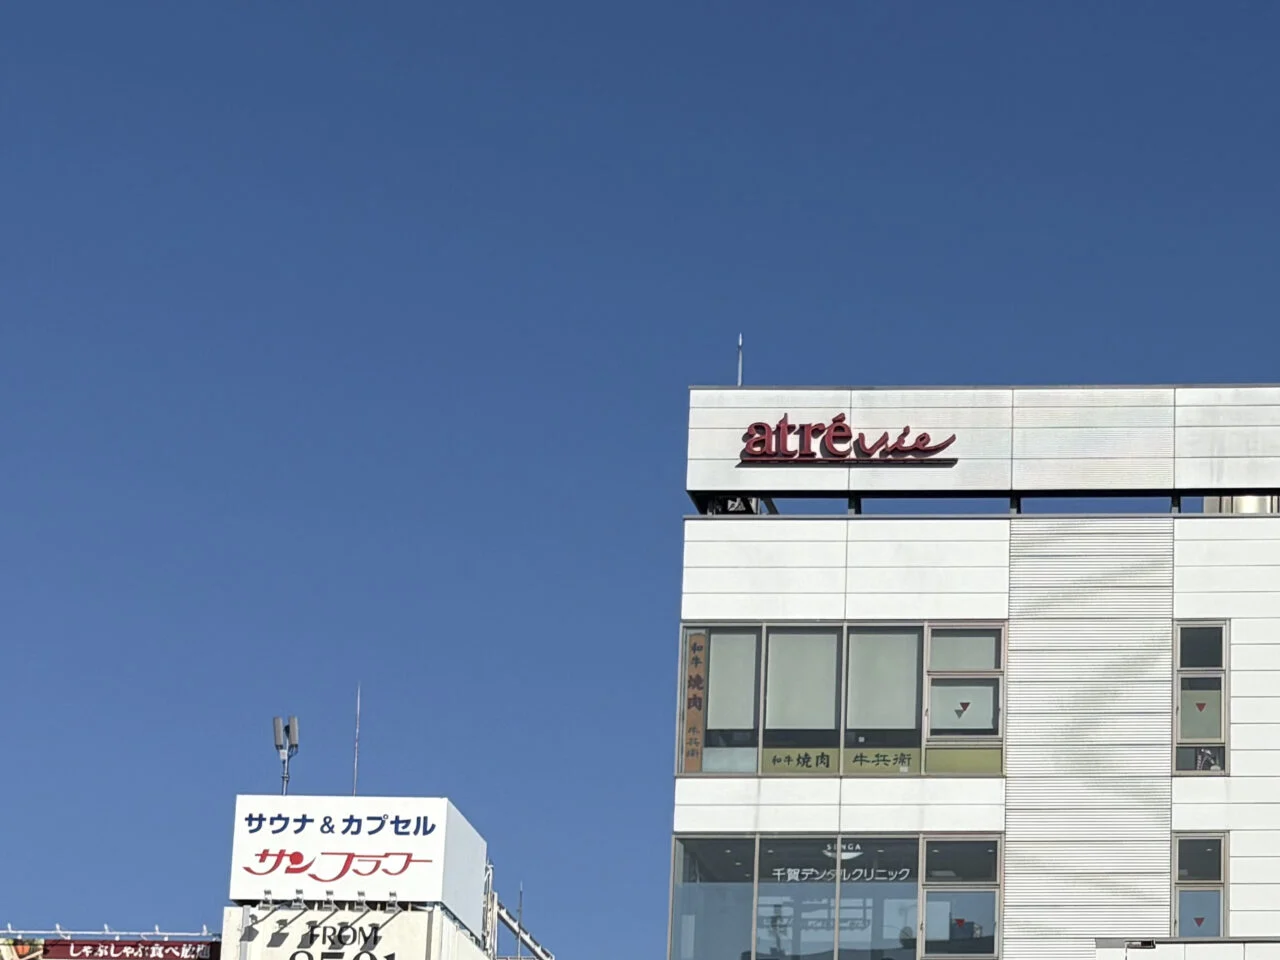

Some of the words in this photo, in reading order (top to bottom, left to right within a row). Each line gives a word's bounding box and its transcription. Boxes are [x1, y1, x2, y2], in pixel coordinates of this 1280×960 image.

[772, 751, 831, 768] 和牛焼肉
[826, 843, 862, 851] SNGA
[772, 867, 911, 882] 千賀デンタルクリニック
[307, 925, 380, 946] FROM
